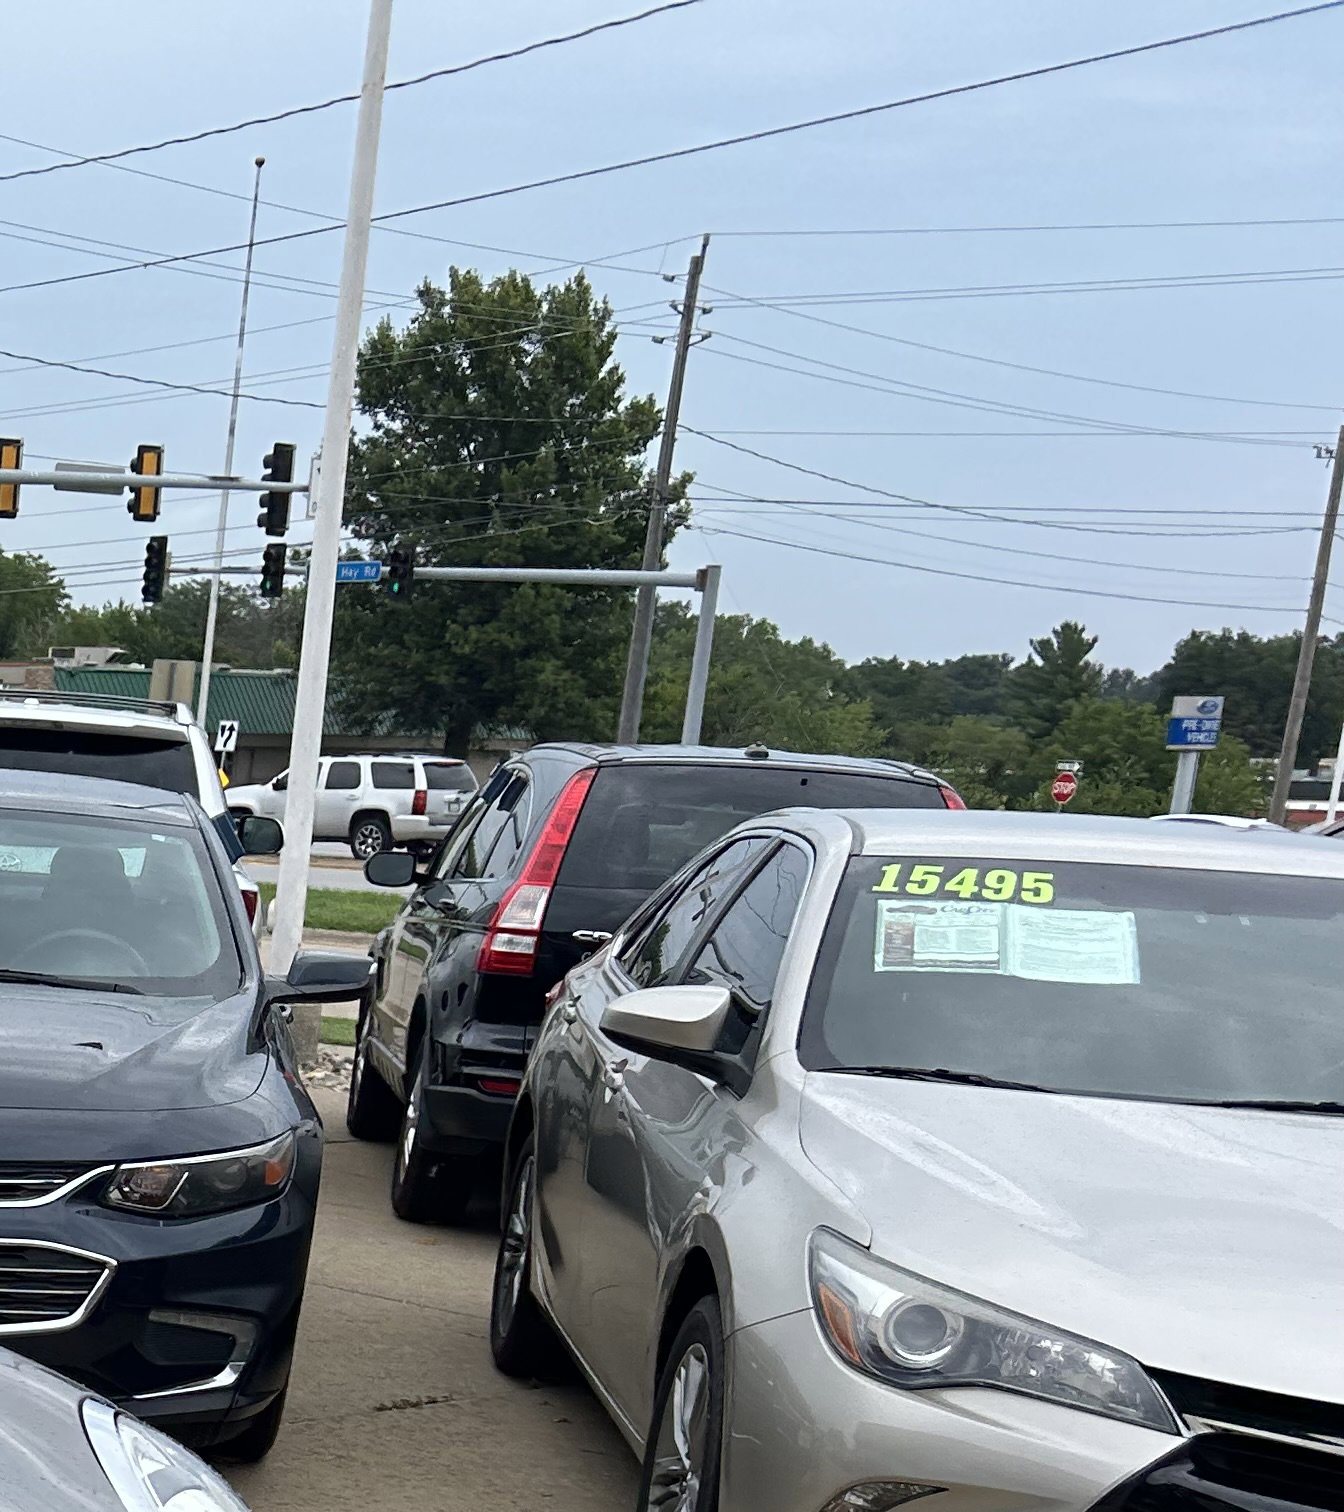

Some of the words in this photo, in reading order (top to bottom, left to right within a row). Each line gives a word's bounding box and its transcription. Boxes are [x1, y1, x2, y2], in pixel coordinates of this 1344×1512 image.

[341, 566, 360, 580] Hay
[364, 565, 377, 577] Rd
[1053, 781, 1076, 794] STOP
[871, 863, 1055, 904] 15495
